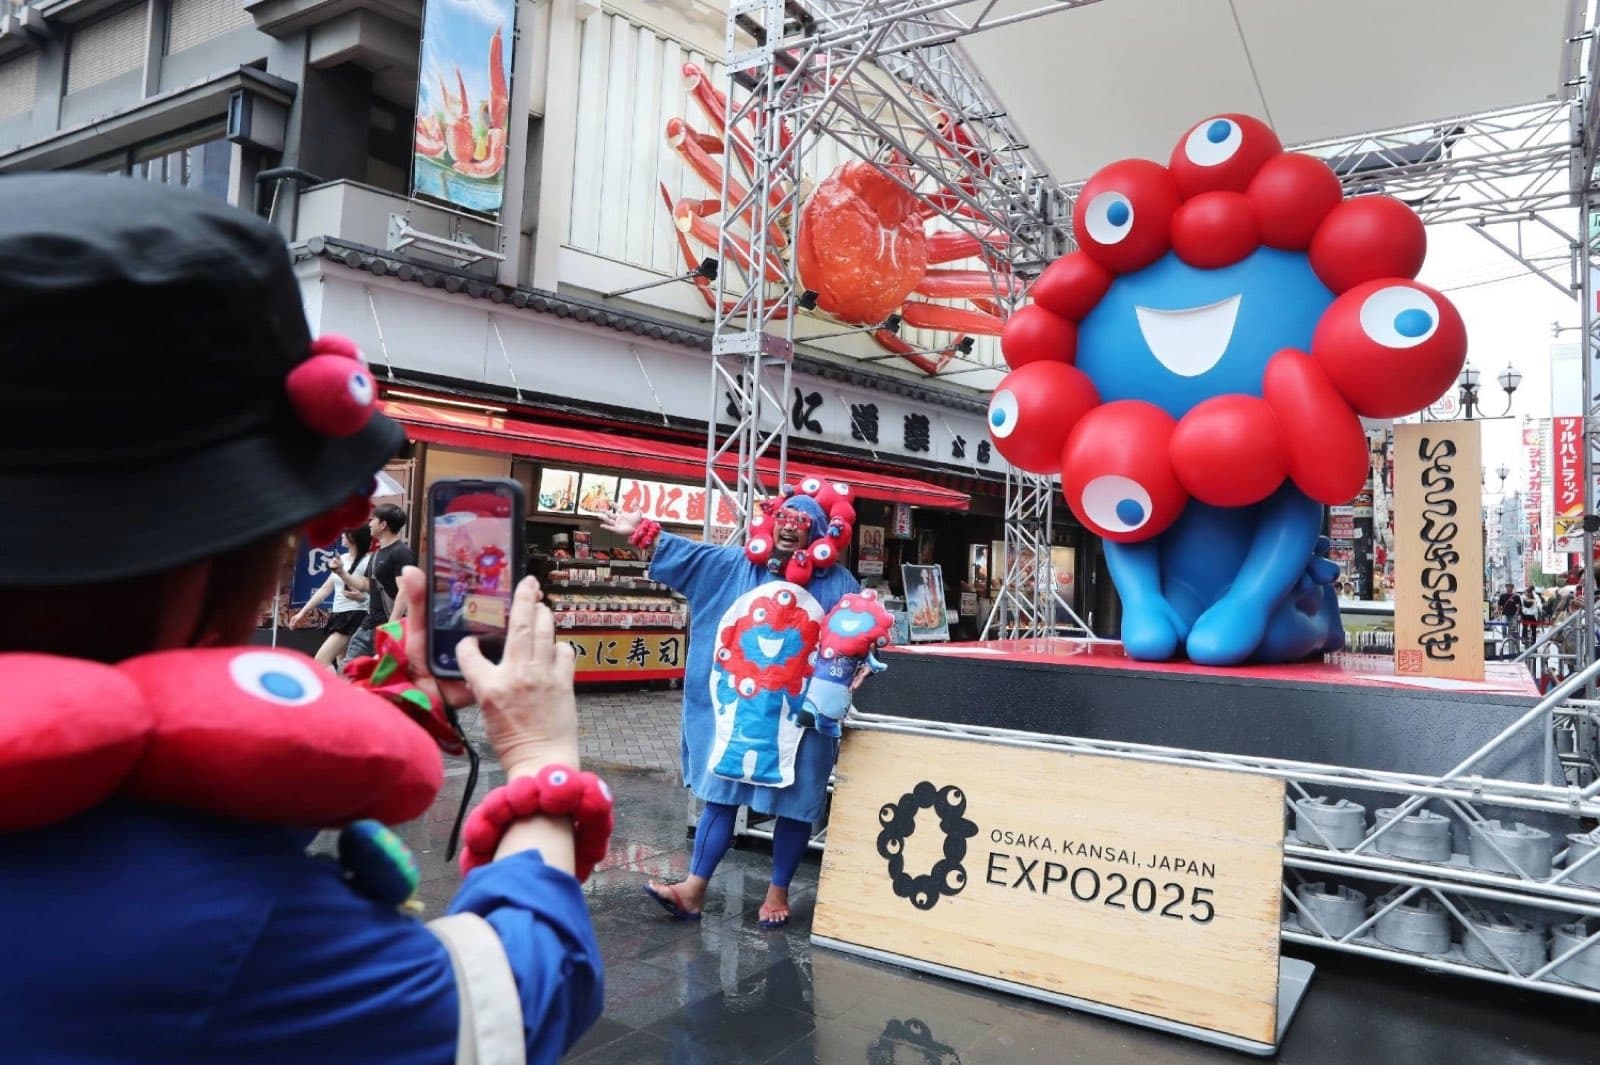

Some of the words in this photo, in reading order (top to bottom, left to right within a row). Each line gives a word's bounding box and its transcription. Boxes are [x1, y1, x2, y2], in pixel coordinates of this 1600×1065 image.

[1559, 418, 1580, 505] ツルハドラッグ
[985, 851, 1216, 924] EXPO2025
[990, 828, 1057, 855] OSAKA,
[1062, 839, 1142, 869] KANSAI,
[1146, 853, 1216, 879] JAPAN
